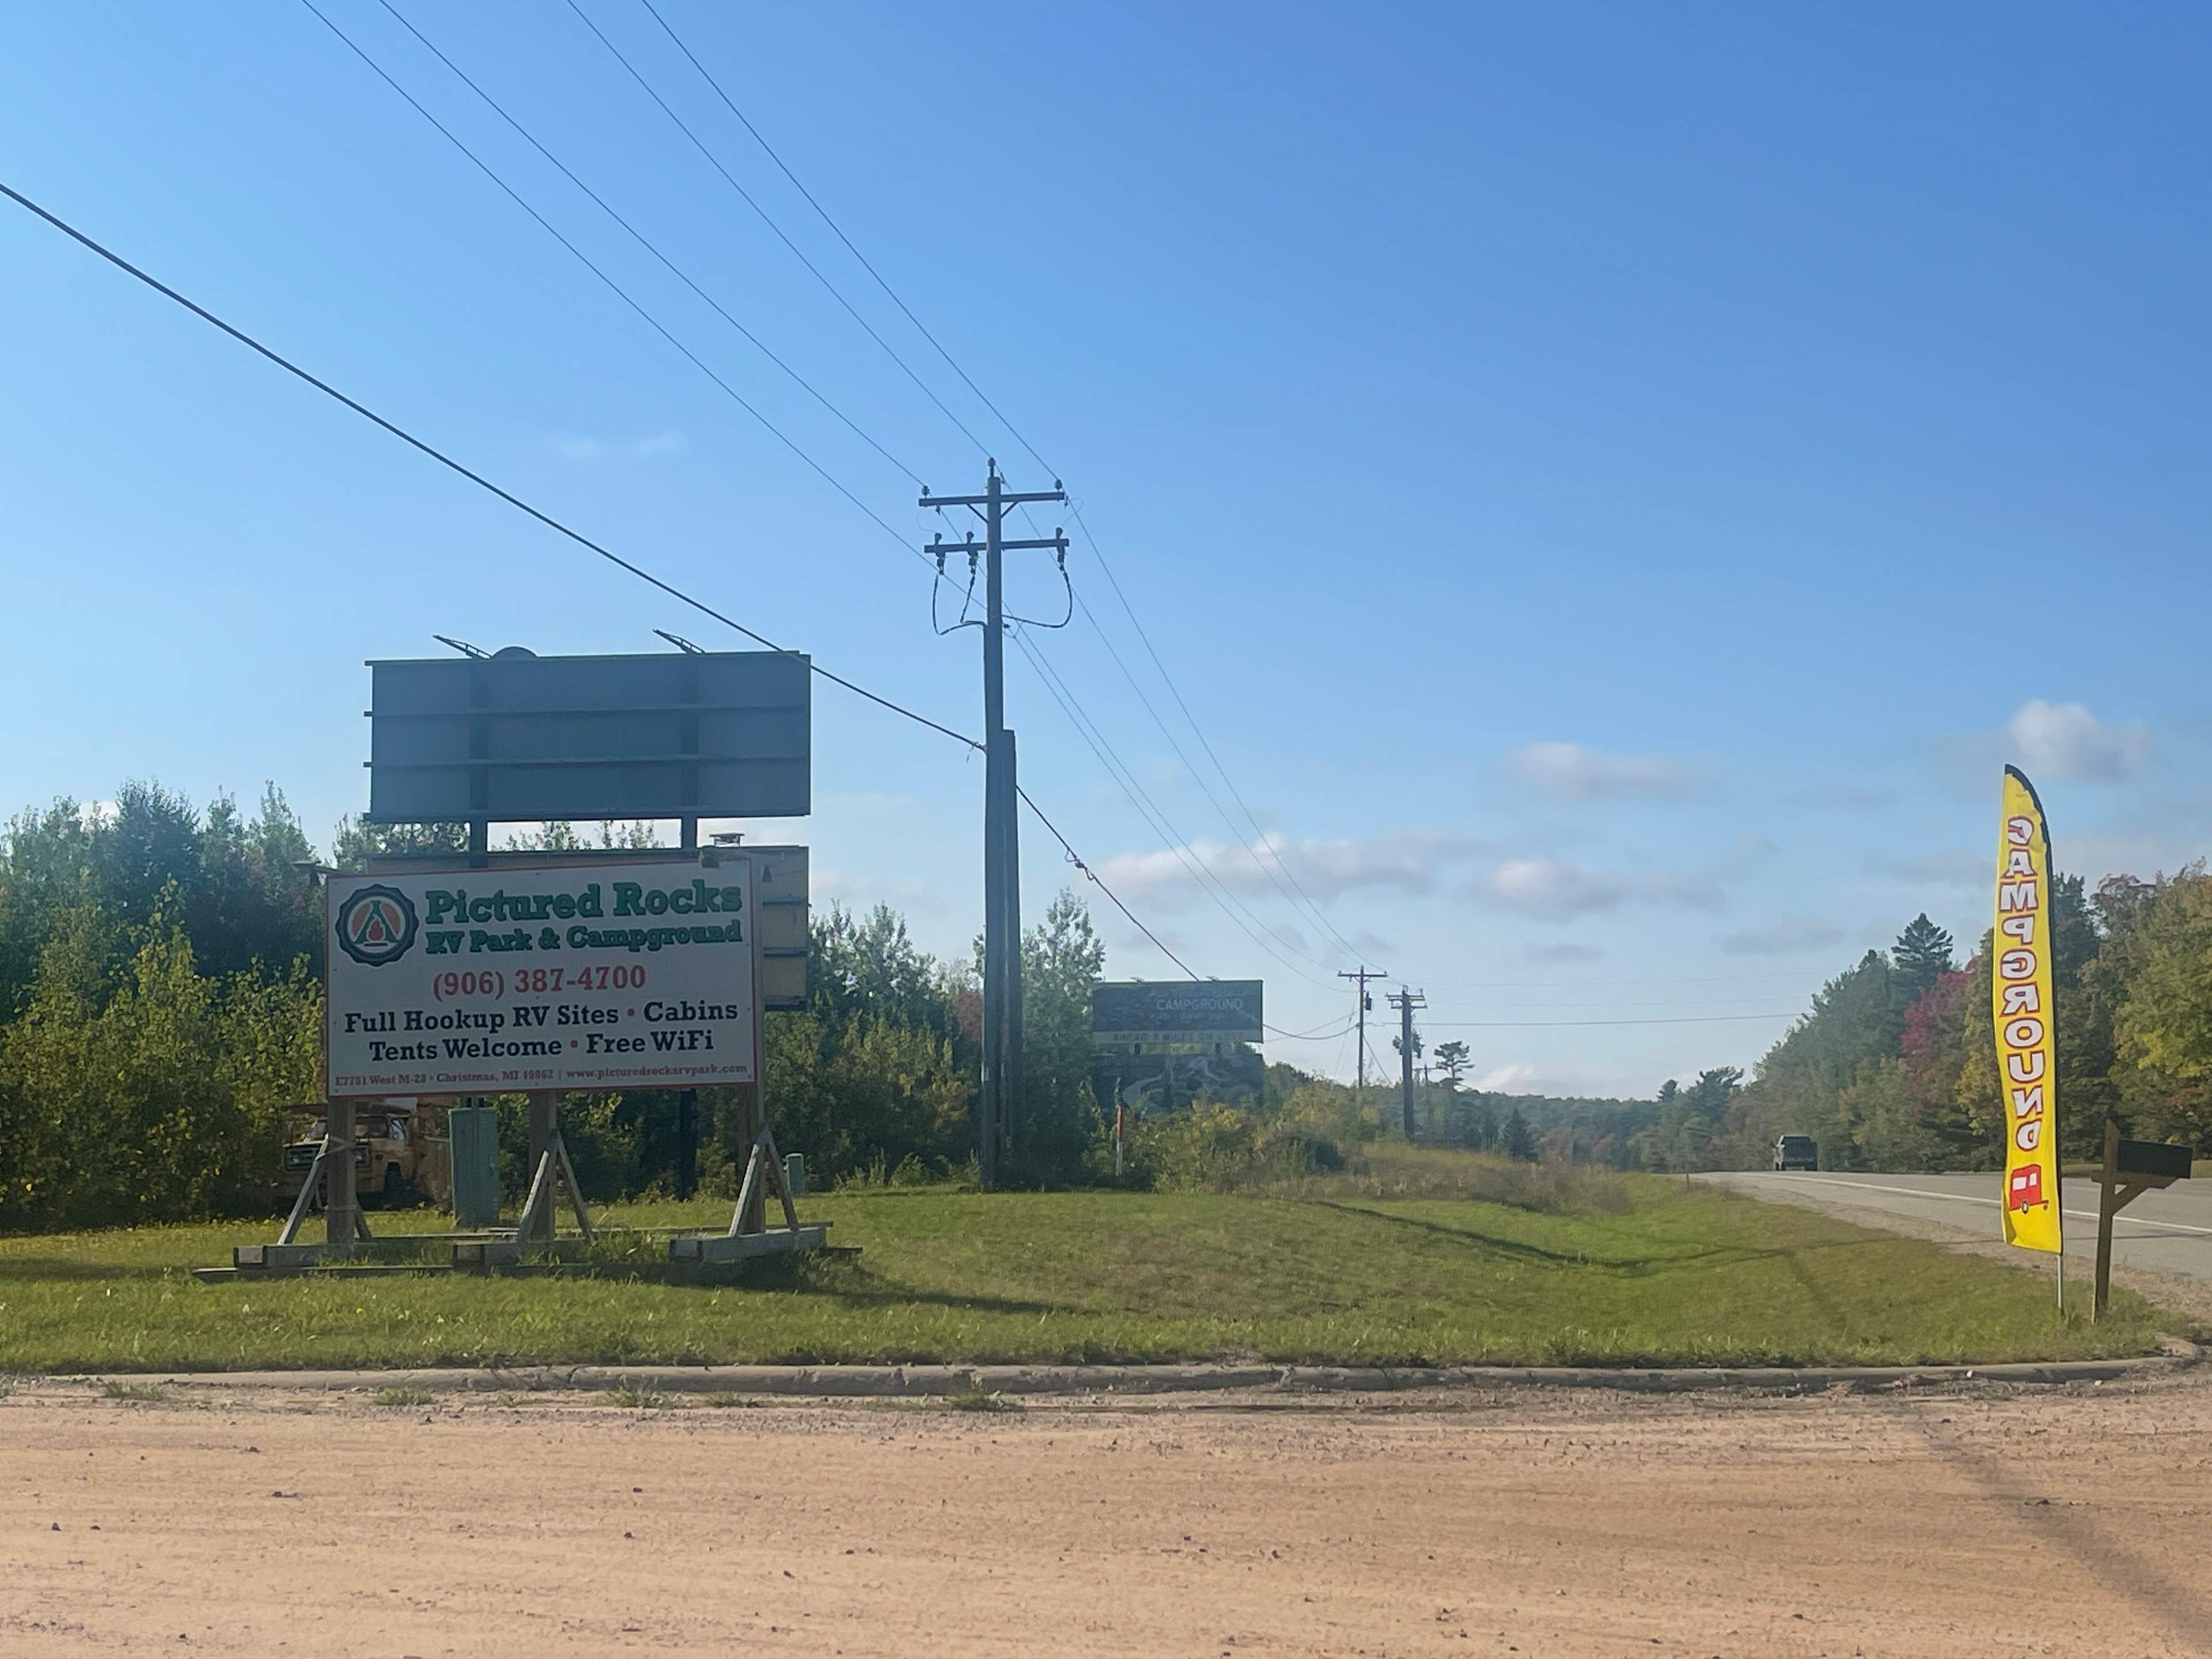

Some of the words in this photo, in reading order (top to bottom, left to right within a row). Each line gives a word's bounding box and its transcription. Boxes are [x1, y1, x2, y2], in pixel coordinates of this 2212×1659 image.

[425, 883, 604, 924] Pictured
[612, 879, 743, 917] Rocks
[426, 931, 465, 955] RV
[469, 928, 533, 953] Park
[538, 927, 561, 950] &
[566, 919, 743, 953] Campground
[433, 971, 505, 1002] (906)
[514, 965, 646, 994] 387-4700
[344, 1012, 396, 1033] Full
[404, 1009, 505, 1034] Hookup
[513, 1006, 550, 1027] RV
[557, 1004, 619, 1026] Sites
[643, 1000, 738, 1022] Cabins
[1157, 998, 1243, 1011] CAMPGROUND
[369, 1041, 438, 1061] Tents
[442, 1037, 562, 1059] Welcome
[586, 1033, 646, 1054] Free
[650, 1029, 714, 1051] WiFi
[369, 1074, 396, 1085] West
[437, 1072, 499, 1083] Christmas,
[502, 1070, 519, 1081] MI
[522, 1069, 554, 1080] 49862
[566, 1063, 748, 1080] www.picturedrocksrvpark.com
